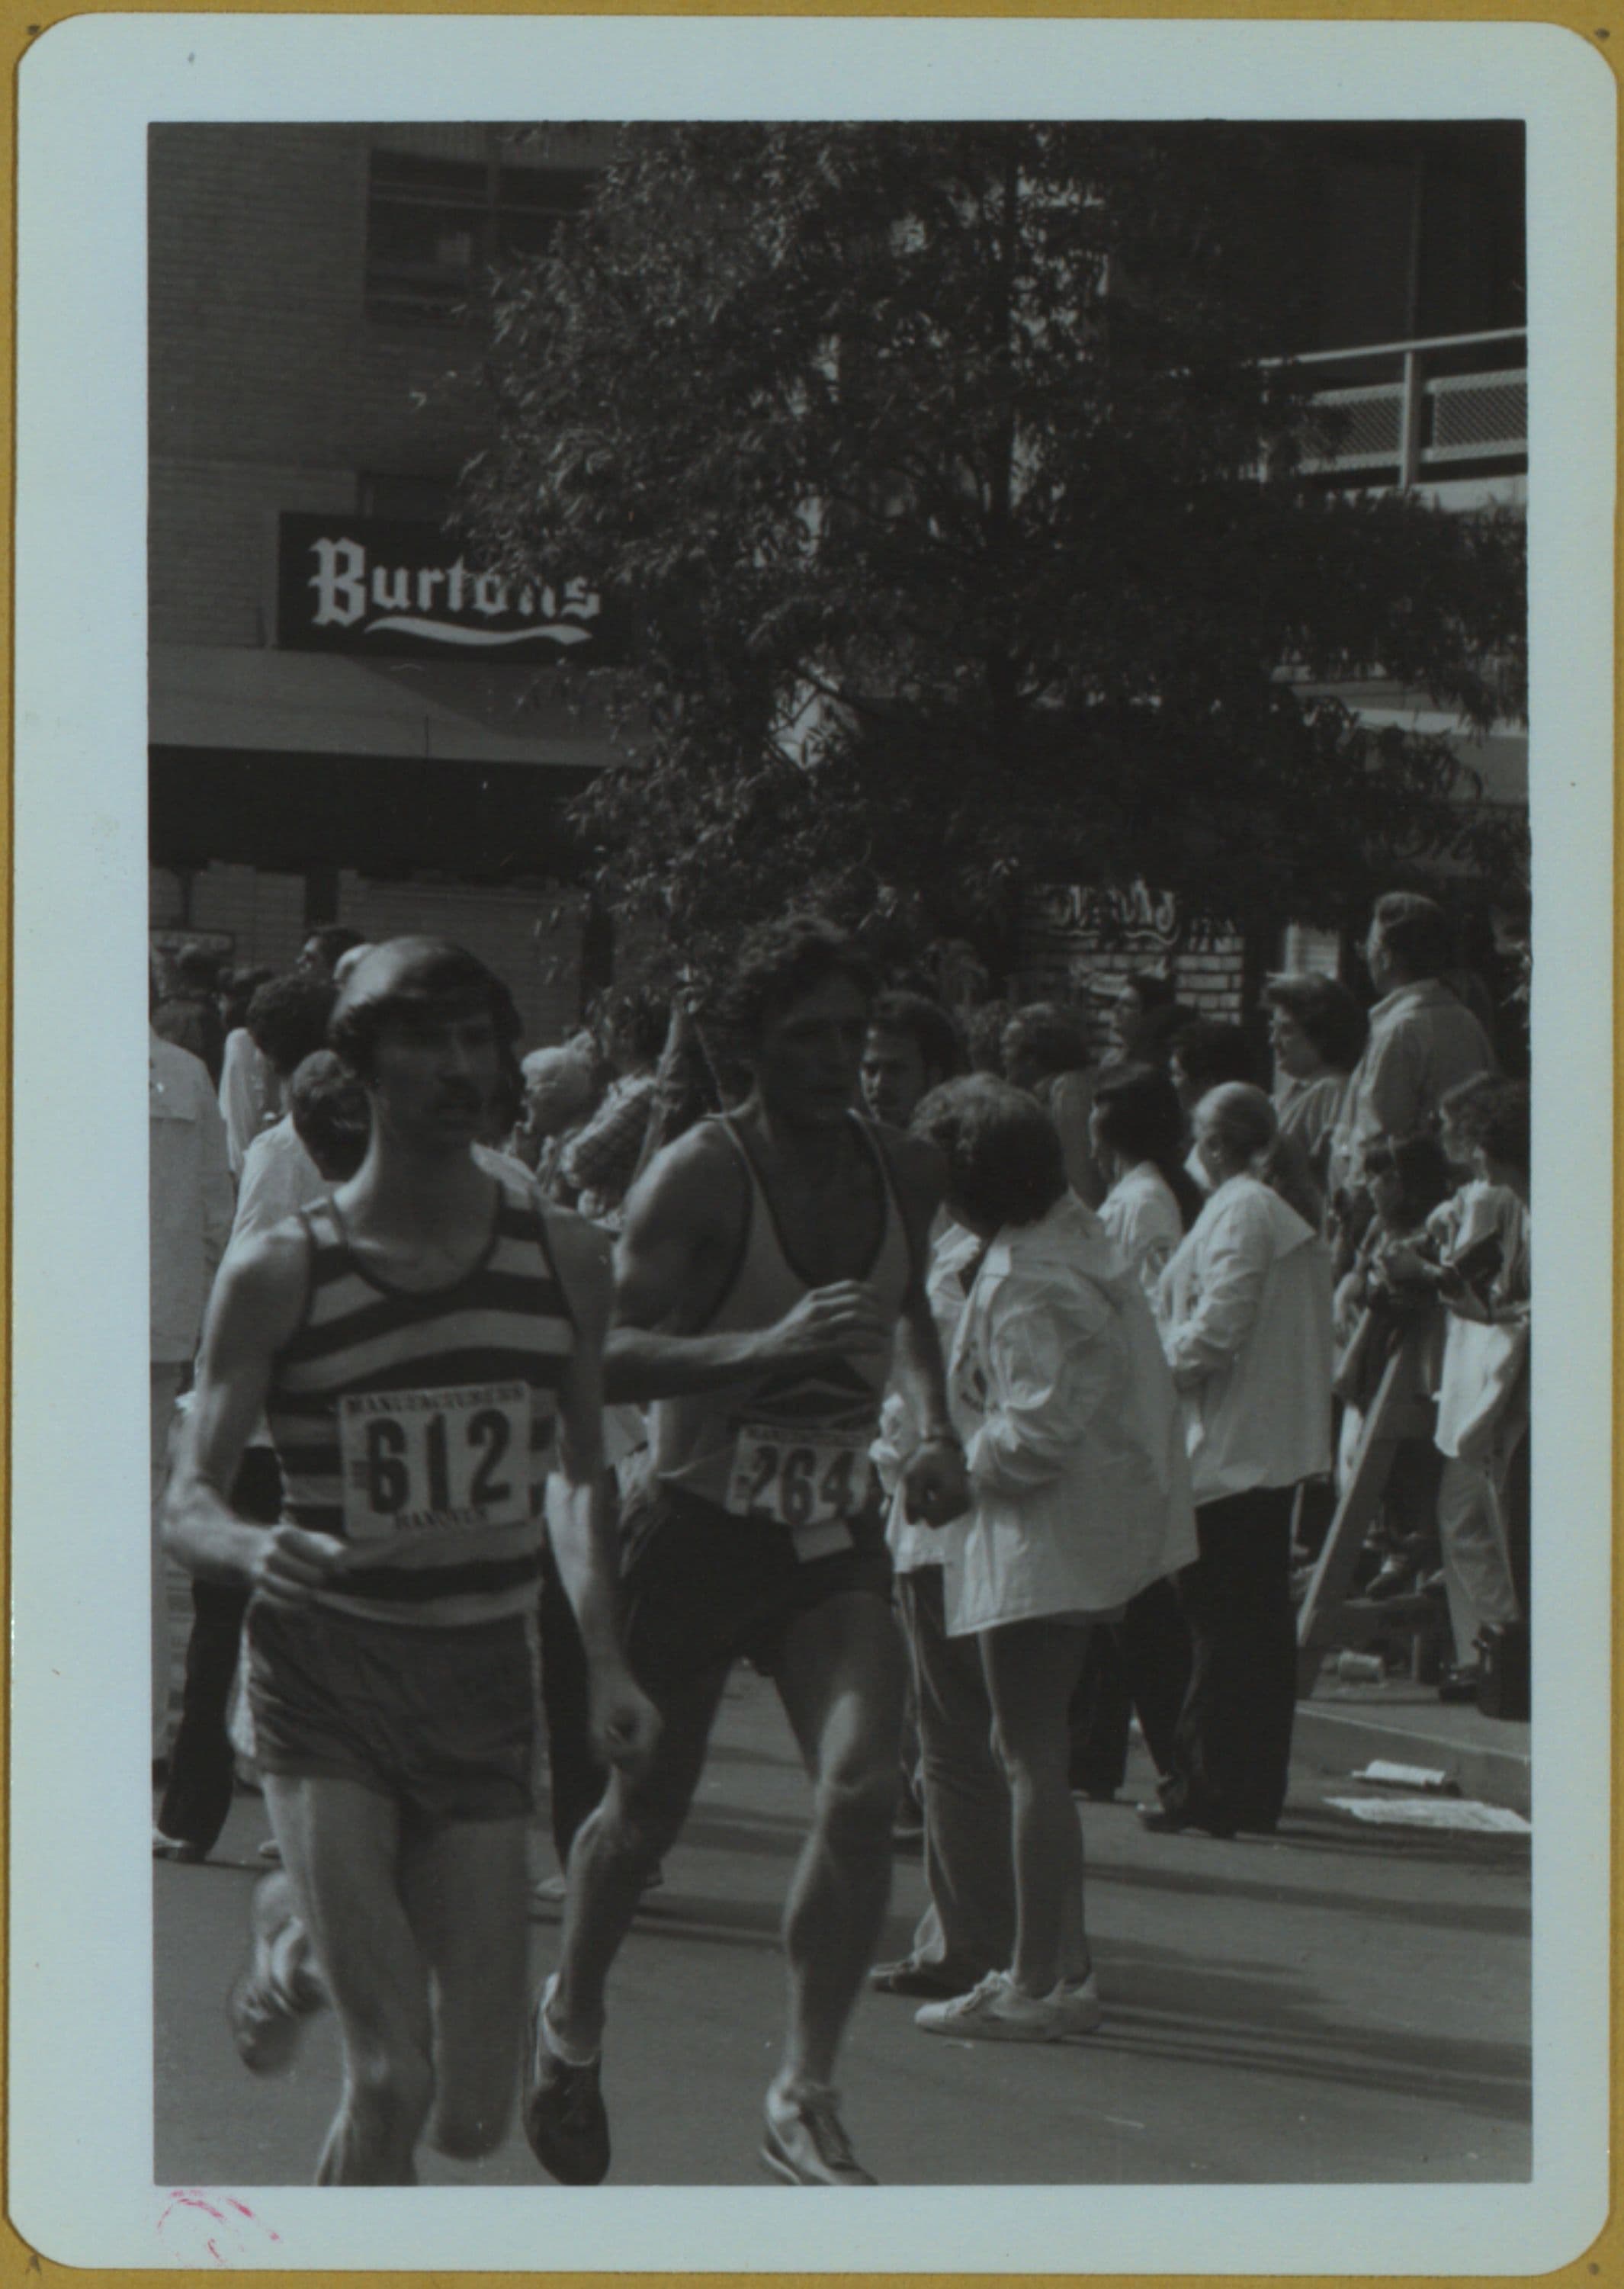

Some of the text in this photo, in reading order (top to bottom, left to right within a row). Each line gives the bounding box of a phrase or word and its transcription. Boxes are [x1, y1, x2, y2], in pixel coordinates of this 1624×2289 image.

[309, 536, 601, 627] Burtons
[366, 1408, 511, 1514] 612
[746, 1446, 854, 1523] 264
